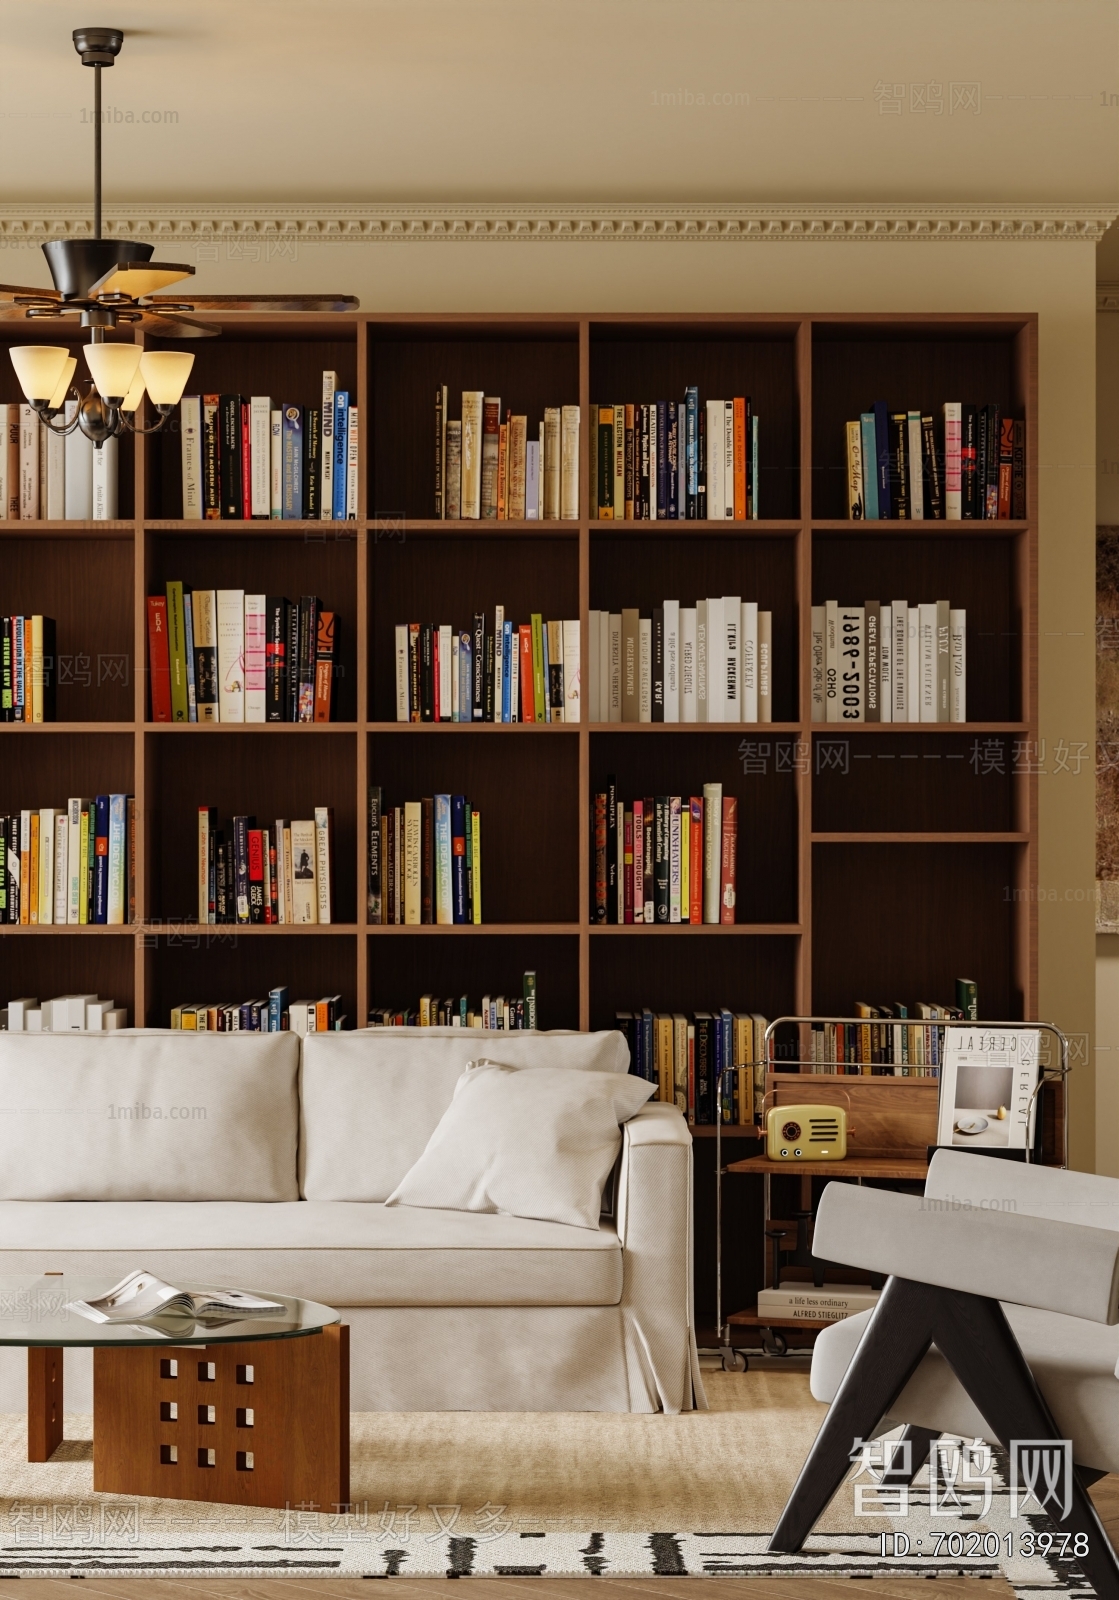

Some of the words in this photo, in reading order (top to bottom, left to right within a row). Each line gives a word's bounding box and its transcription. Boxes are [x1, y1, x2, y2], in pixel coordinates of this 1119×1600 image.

[337, 394, 346, 408] on
[324, 402, 332, 437] MIND
[350, 412, 358, 427] MIND
[10, 424, 18, 444] PUUR
[335, 408, 346, 465] intelligence
[350, 429, 358, 444] WIDE
[186, 437, 195, 471] Frames
[350, 446, 358, 461] OPEN
[1015, 447, 1023, 479] KOFFIE
[187, 473, 195, 481] of
[10, 497, 18, 512] THEE
[187, 483, 196, 507] Mind
[504, 624, 511, 634] on
[16, 658, 22, 666] IN
[440, 821, 448, 841] THE
[371, 830, 379, 876] ELEMENTS
[440, 843, 448, 865] IDEA
[319, 860, 327, 910] PHYSICISTS
[440, 866, 448, 911] FACTORY
[699, 1020, 708, 1034] THE
[699, 1034, 707, 1077] DISCOVERERS
[795, 1297, 805, 1305] life
[807, 1297, 819, 1306] less
[820, 1298, 849, 1309] ordinary
[793, 1310, 817, 1318] ALFRED
[818, 1311, 848, 1320] STIEGLITZ
